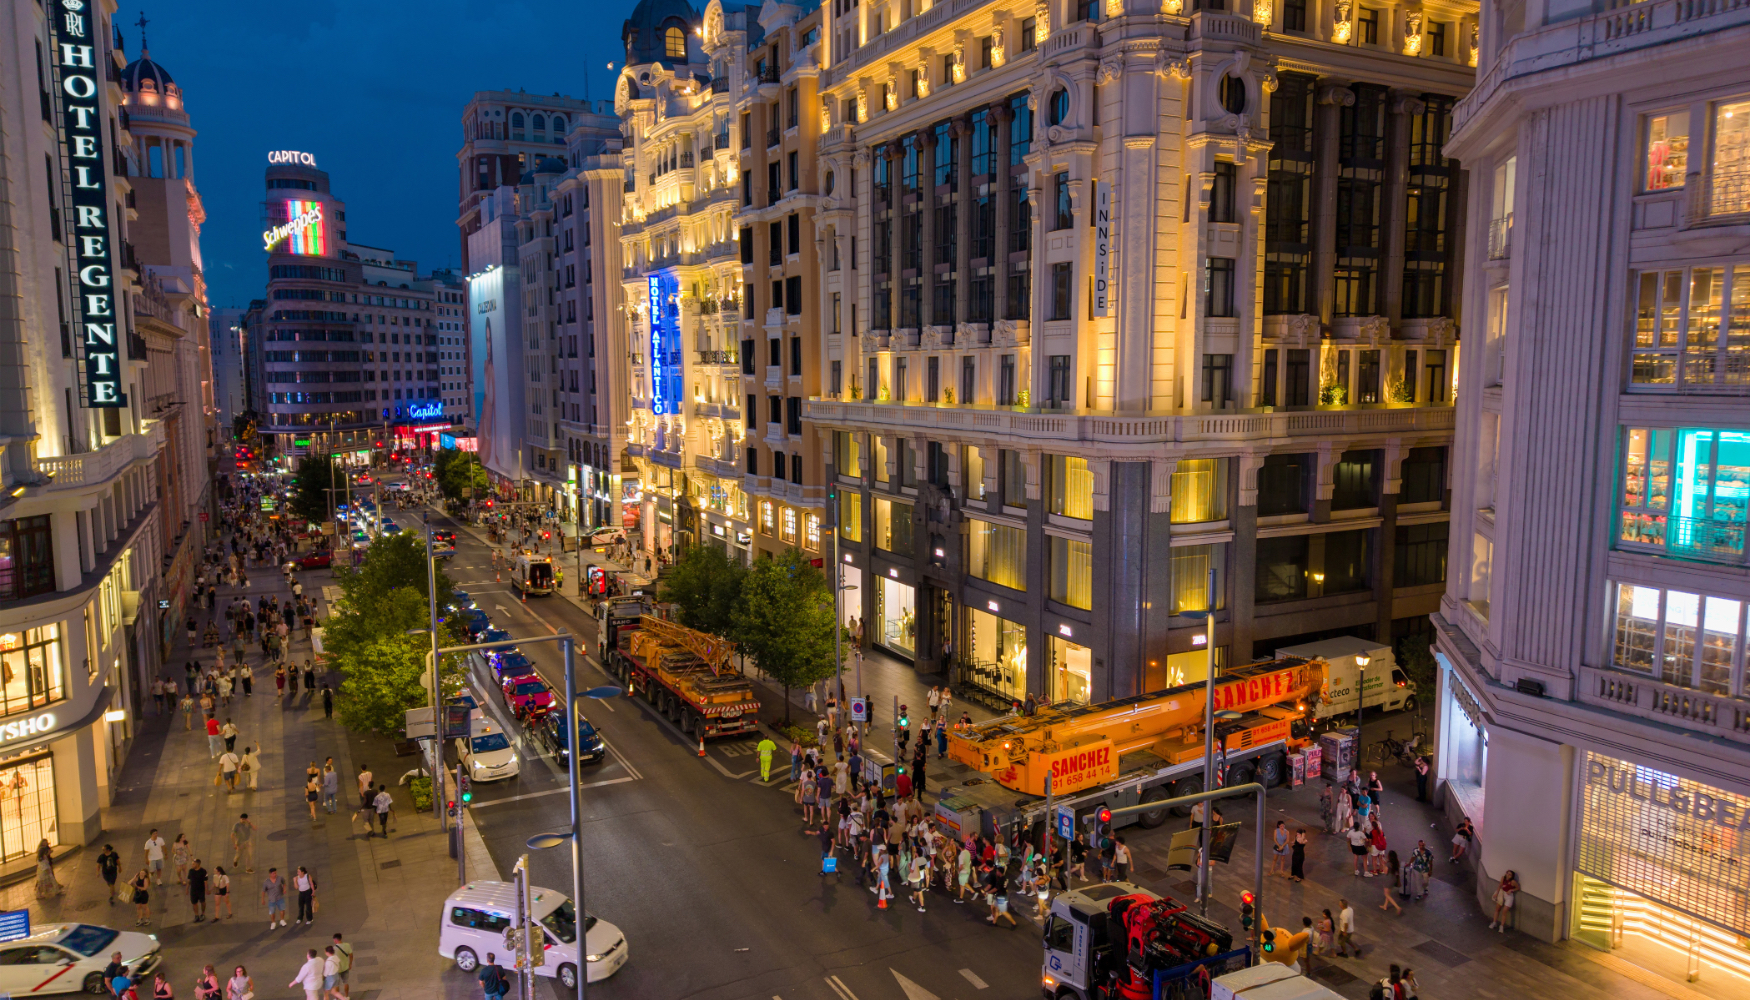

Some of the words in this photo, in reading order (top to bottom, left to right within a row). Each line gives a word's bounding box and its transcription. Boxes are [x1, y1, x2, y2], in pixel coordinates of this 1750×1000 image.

[59, 43, 98, 188] HOTEL
[267, 150, 317, 166] CAPITOL
[263, 206, 322, 250] Schweppes
[76, 205, 117, 403] REGENTE
[650, 276, 660, 325] HOTEL
[652, 330, 663, 415] ATLANTICO
[409, 402, 443, 420] Capitol
[1214, 671, 1294, 712] SANCHEZ
[1052, 747, 1110, 779] SANCHEZ
[1052, 778, 1063, 790] 91
[1066, 772, 1083, 786] 658
[1086, 769, 1097, 780] 44
[1100, 765, 1111, 776] 14
